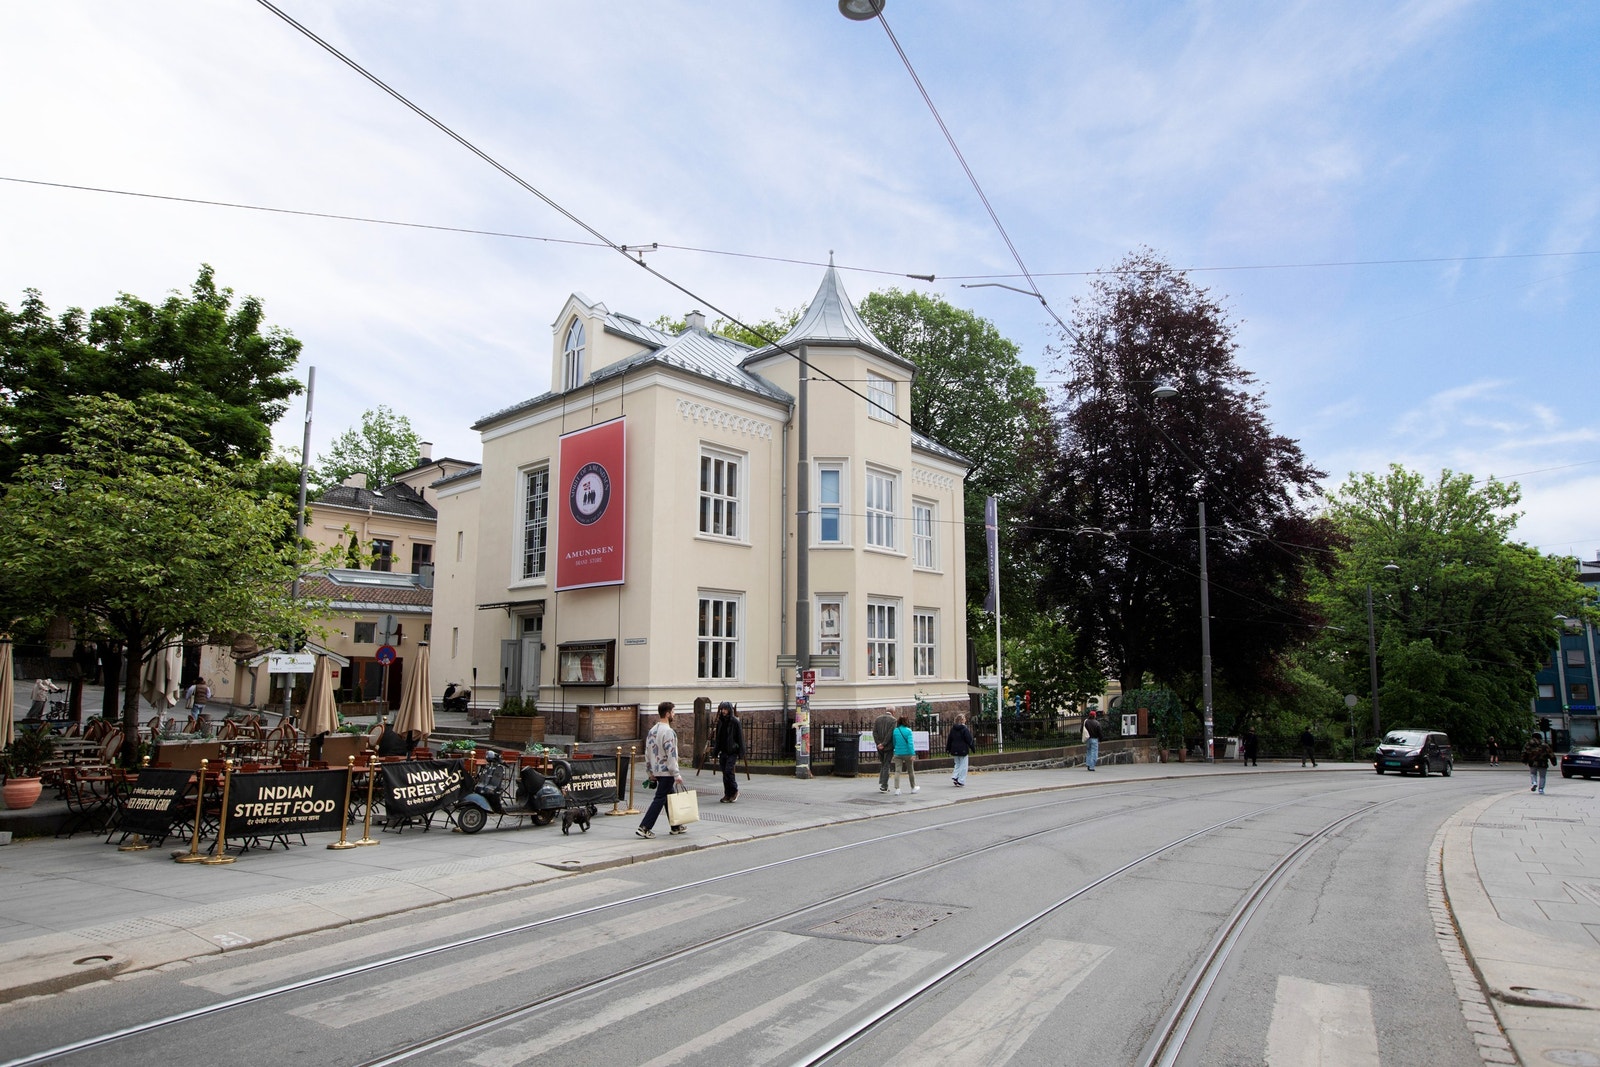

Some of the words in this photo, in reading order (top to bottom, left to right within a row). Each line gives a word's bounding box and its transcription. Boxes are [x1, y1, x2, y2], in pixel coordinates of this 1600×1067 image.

[565, 546, 614, 559] AMUNDSEN
[406, 768, 450, 784] INDIAN
[258, 785, 314, 800] INDIAN
[393, 783, 437, 800] STREET
[572, 780, 602, 792] PEPPERN
[233, 801, 292, 818] STREET
[293, 799, 336, 814] FOOD
